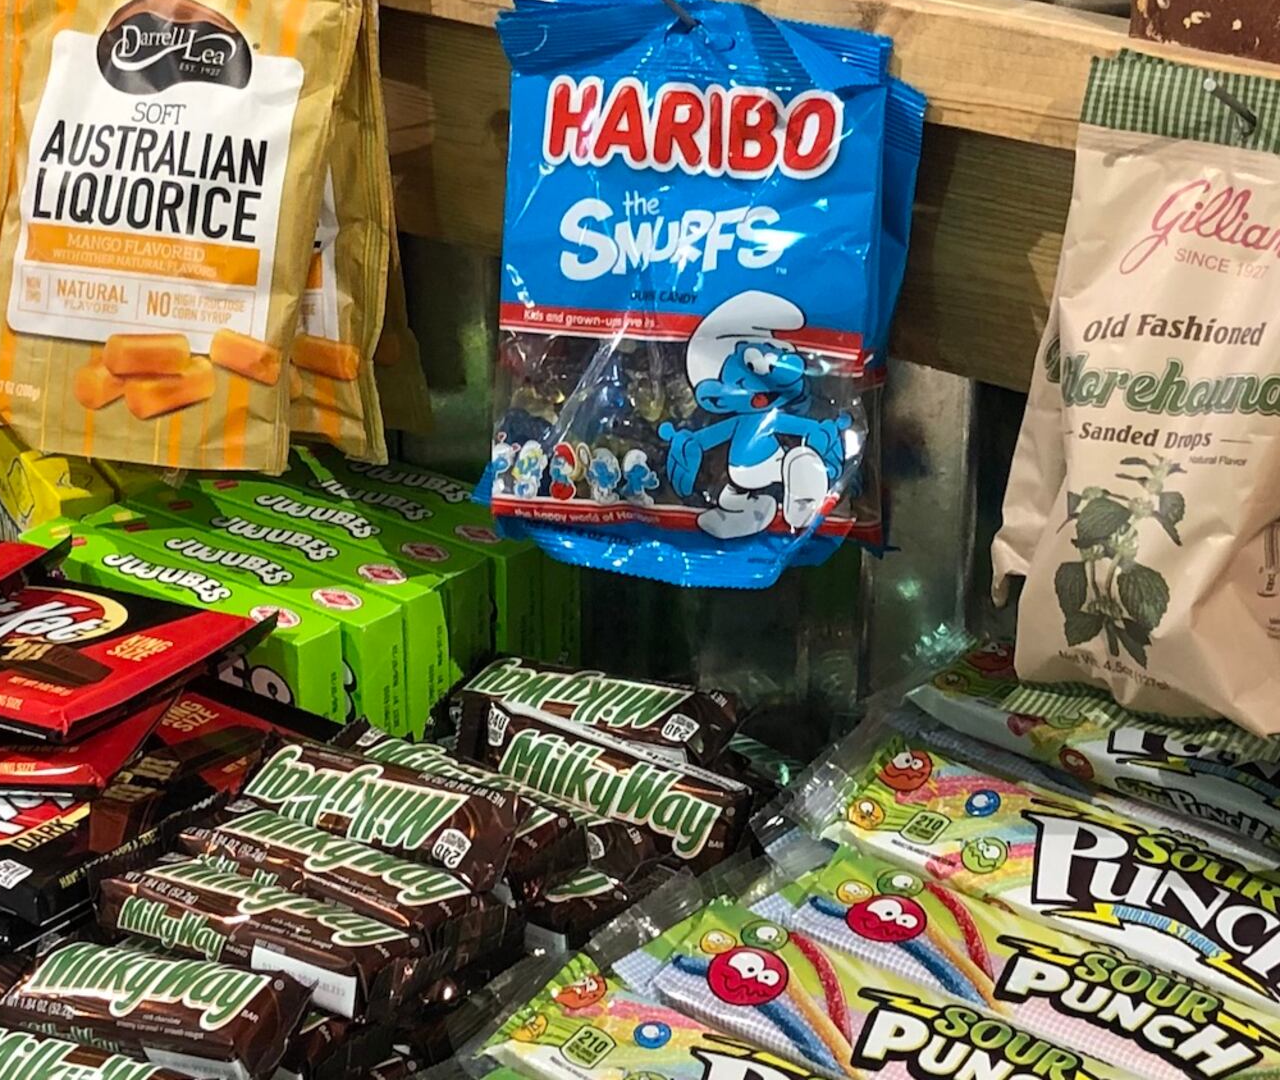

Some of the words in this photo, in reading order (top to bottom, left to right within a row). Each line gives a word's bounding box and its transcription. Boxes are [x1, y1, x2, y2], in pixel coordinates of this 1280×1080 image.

[118, 24, 186, 59] Darrell
[183, 27, 226, 67] Lea
[200, 65, 221, 77] 1927
[131, 101, 187, 126] SOFT
[547, 81, 837, 173] HARIBO
[40, 120, 269, 188] AUSTRALIAN
[32, 167, 261, 243] LIQUORICE
[623, 190, 660, 217] the
[67, 232, 122, 252] MANGO
[124, 238, 206, 263] FLAVORED
[559, 196, 788, 282] SMURFS
[53, 248, 77, 261] WITH
[78, 250, 115, 265] OTHER
[115, 254, 163, 272] NATURAL
[164, 259, 218, 279] FLAVORS
[1174, 247, 1231, 274] SINCE
[1236, 261, 1270, 281] 1927
[57, 278, 129, 306] NATURAL
[146, 290, 171, 317] NO
[173, 292, 196, 309] HIGH
[198, 295, 246, 314] FRUCTOSE
[659, 290, 698, 306] CANDY
[64, 298, 119, 316] FLAVORS
[172, 305, 198, 322] CORN
[200, 309, 232, 325] SYRUP
[524, 309, 544, 323] Kids
[545, 311, 564, 324] and
[1083, 313, 1132, 344] Old
[1136, 313, 1267, 348] Fashioned
[1078, 422, 1158, 447] Sanded
[1165, 429, 1212, 451] Drops
[1189, 455, 1219, 466] Natural
[1221, 456, 1248, 468] Flavor
[532, 511, 565, 525] happy
[106, 647, 152, 663] SIZE
[123, 634, 175, 655] KING
[175, 707, 220, 733] SIZE
[9, 816, 80, 852] DARK
[916, 813, 944, 834] 210
[1111, 903, 1171, 932] RAINBOW
[1175, 924, 1222, 959] STRAWS
[1074, 953, 1220, 1022] SOUR
[240, 1009, 260, 1023] BAR
[1003, 958, 1259, 1077] PUNCH
[576, 1030, 610, 1057] 210
[933, 1006, 1080, 1080] SOUR
